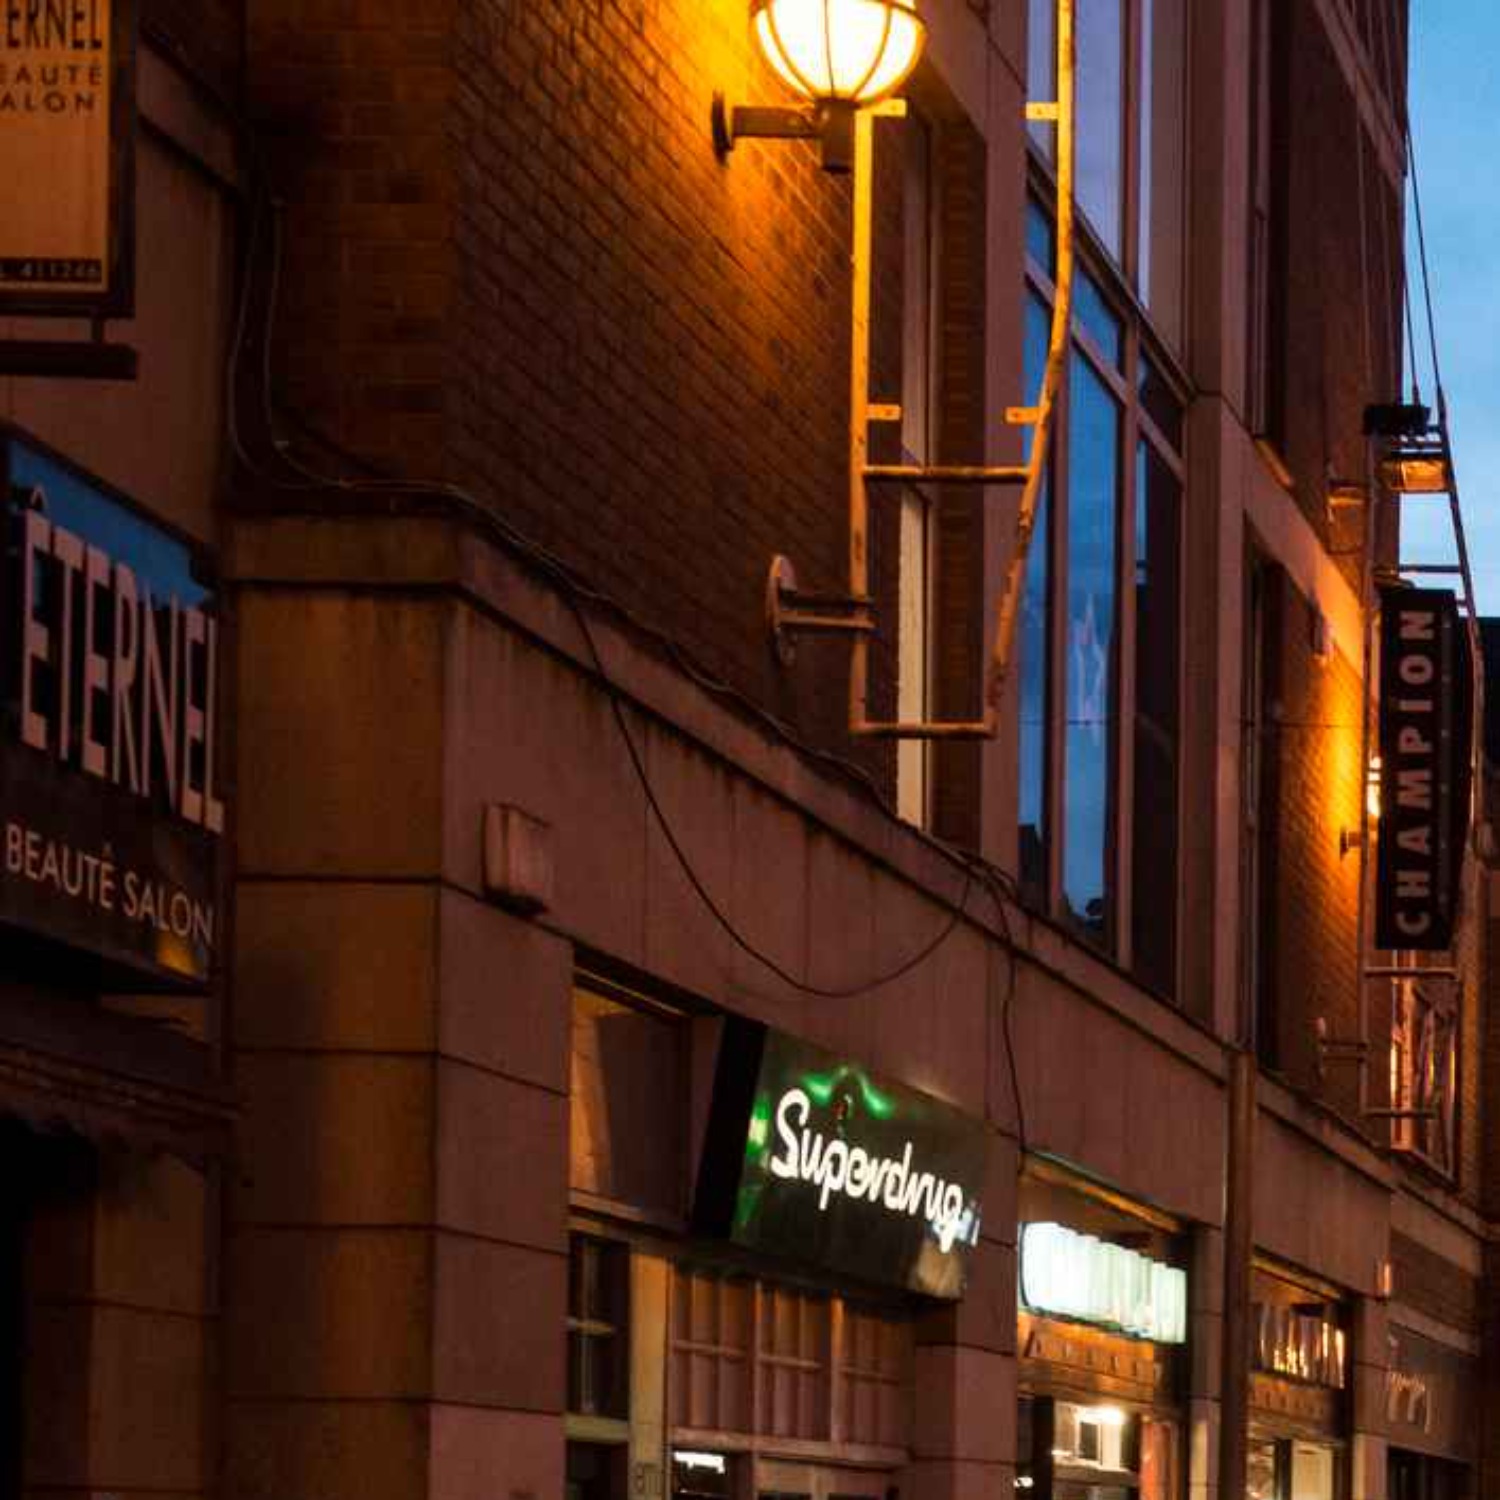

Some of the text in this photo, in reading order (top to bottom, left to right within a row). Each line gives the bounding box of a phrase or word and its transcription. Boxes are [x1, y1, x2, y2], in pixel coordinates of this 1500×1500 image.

[1396, 610, 1436, 936] CHAMPION
[122, 867, 213, 945] SALON
[770, 1088, 963, 1254] Superdrug
